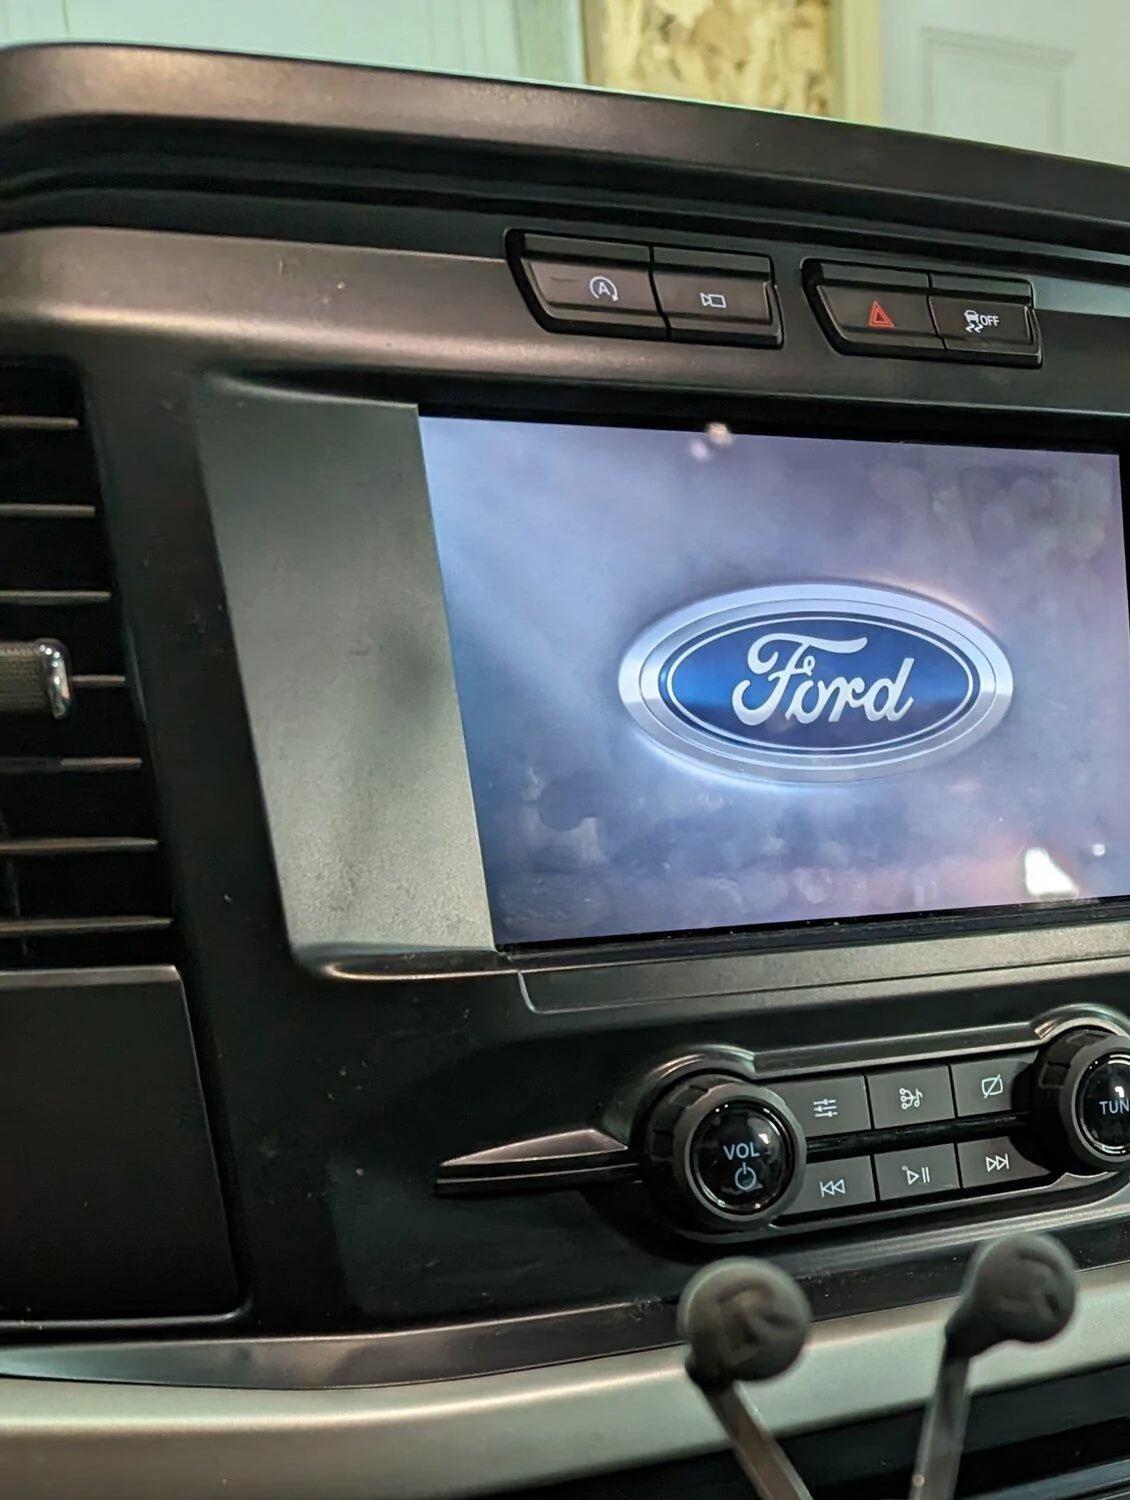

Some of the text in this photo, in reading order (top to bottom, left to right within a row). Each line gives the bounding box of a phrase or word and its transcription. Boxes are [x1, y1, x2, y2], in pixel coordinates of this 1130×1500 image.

[979, 314, 1000, 327] OFF
[732, 632, 915, 726] Ford
[722, 1141, 760, 1160] VOL
